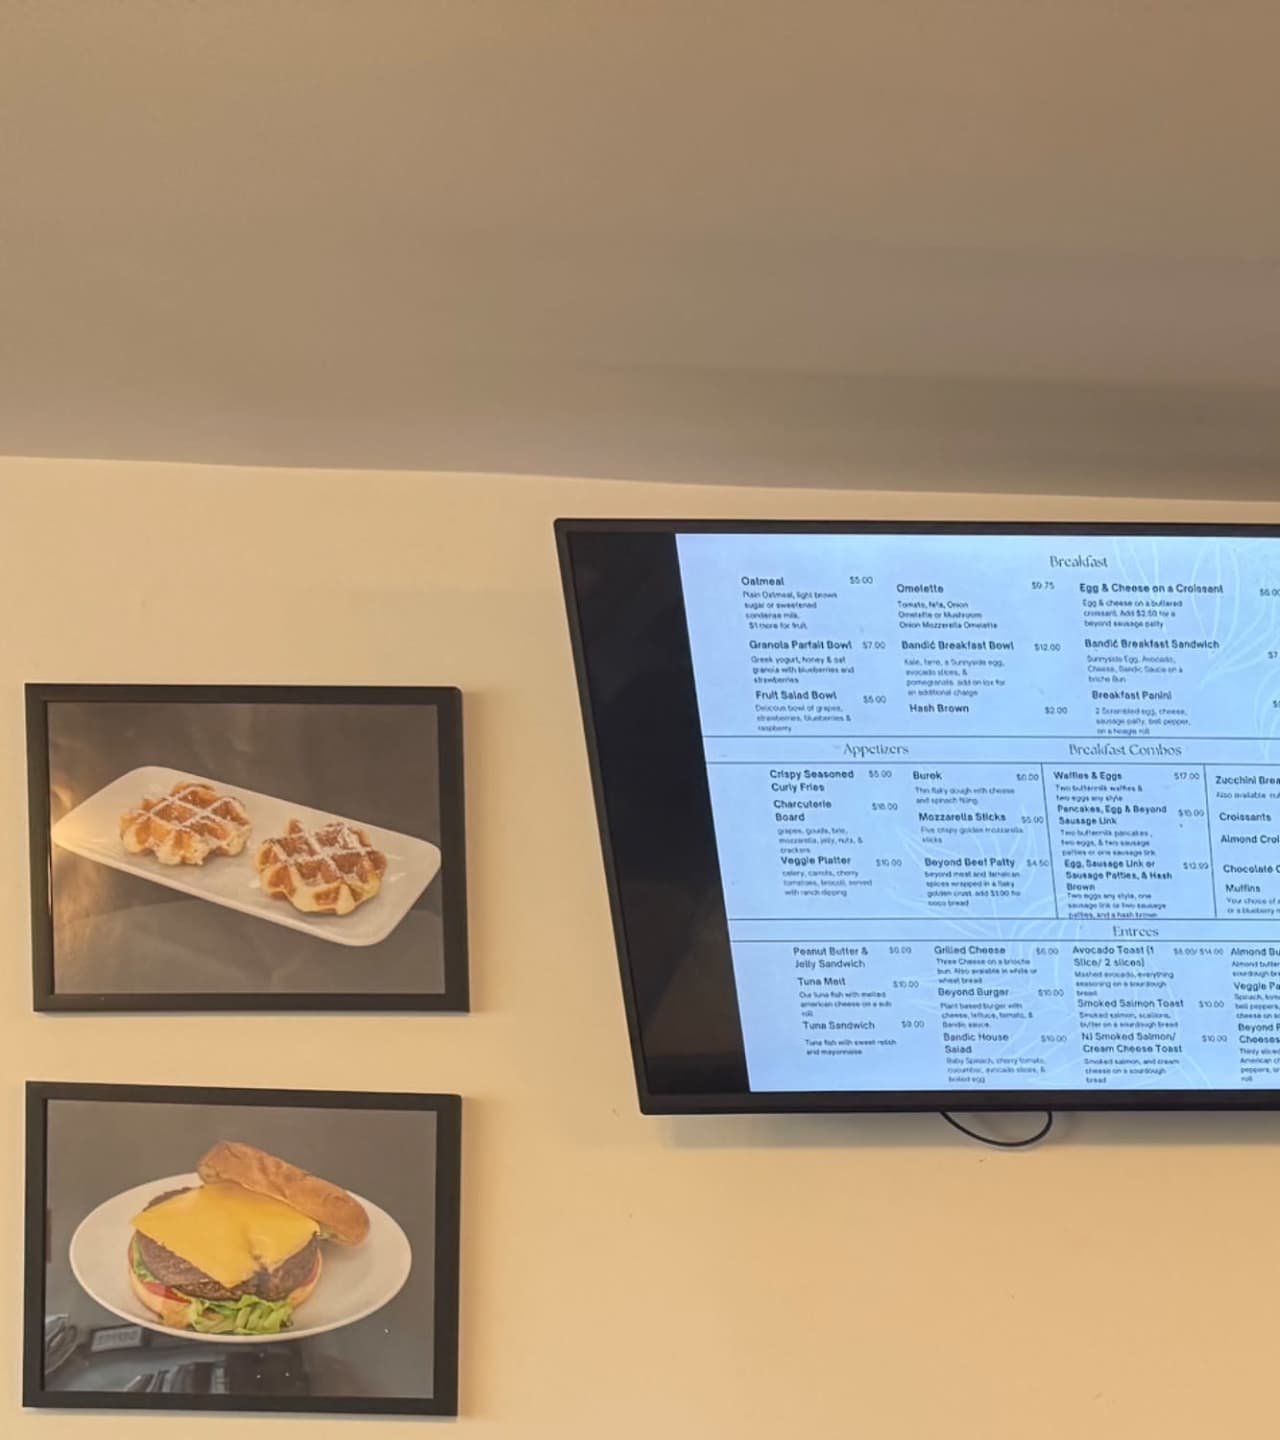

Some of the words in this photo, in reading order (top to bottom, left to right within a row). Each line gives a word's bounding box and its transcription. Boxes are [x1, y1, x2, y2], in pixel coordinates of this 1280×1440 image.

[1049, 554, 1109, 569] Breakfast
[741, 576, 785, 587] Oatmeal
[896, 583, 945, 594] Omelette
[749, 640, 789, 651] Granola
[791, 639, 823, 650] Parfait
[825, 639, 852, 650] Bowl
[938, 639, 987, 651] Breakfast
[988, 640, 1014, 651] Bowl
[1120, 638, 1169, 649] Breakfast
[1171, 639, 1220, 649] Sandwich
[755, 690, 778, 700] Fruit
[780, 690, 809, 700] Salad
[811, 690, 837, 700] Bowl
[1091, 690, 1140, 700] Breakfast
[1142, 690, 1172, 700] Panini
[843, 743, 910, 757] Appetizers
[1068, 743, 1126, 757] Breakfast
[1128, 742, 1182, 757] Combos
[769, 769, 802, 781] Crispy
[803, 769, 855, 779] Seasoned
[912, 770, 943, 781] Burek
[1215, 774, 1255, 786] Zucchini
[771, 782, 797, 794] Curly
[799, 782, 825, 792] Fries
[918, 811, 973, 822] Mozzarella
[976, 812, 1006, 822] Sticks
[1222, 864, 1273, 875] Chocolate
[1112, 925, 1160, 939] Entrees
[1077, 998, 1116, 1010] Smoked
[1118, 998, 1154, 1010] Salmon
[1157, 998, 1184, 1009] Toast
